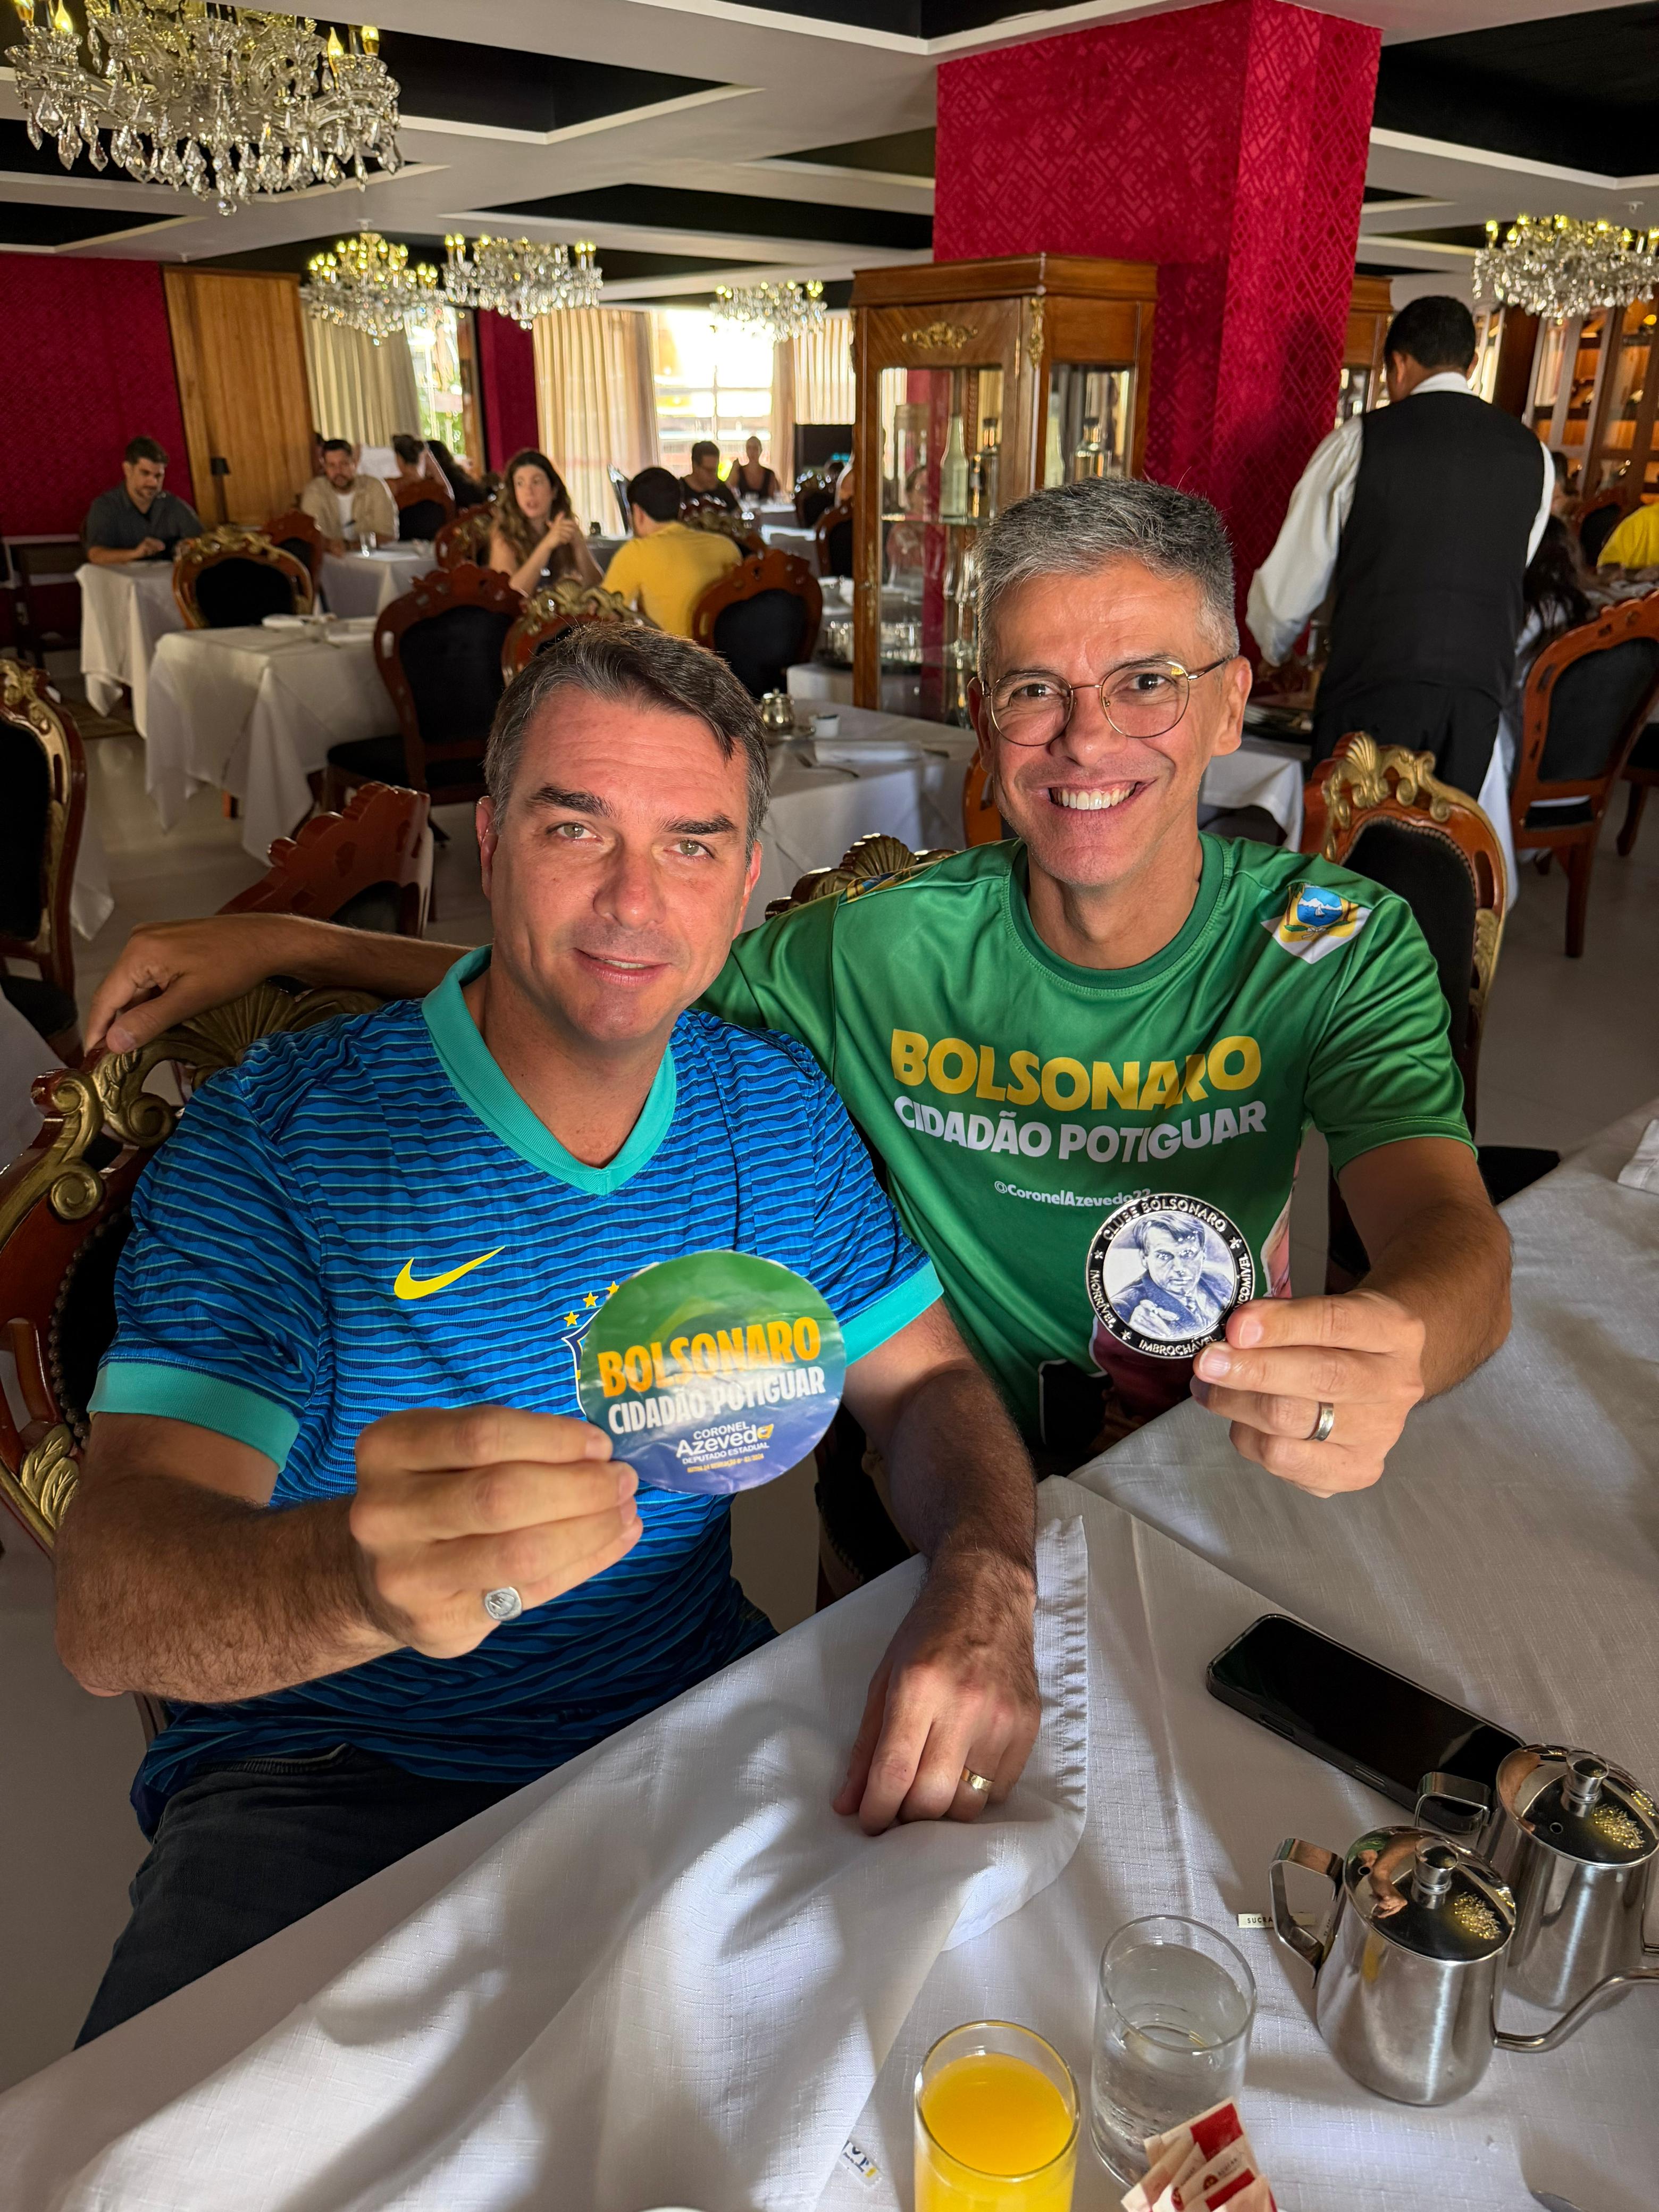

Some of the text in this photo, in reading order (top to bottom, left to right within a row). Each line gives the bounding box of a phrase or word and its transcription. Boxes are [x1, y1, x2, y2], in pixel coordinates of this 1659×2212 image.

[894, 1096, 1267, 1163] CIDADÃO POTIGUAR
[1103, 1198, 1227, 1241] CLUBE BOLSONARO
[597, 1317, 822, 1397] BOLSONARO
[608, 1366, 826, 1435] CIDADÃO POTIGUAR
[682, 1450, 727, 1465] DEPUTADO
[727, 1442, 770, 1456] ESTADUAL
[693, 1421, 750, 1440] CORONEL
